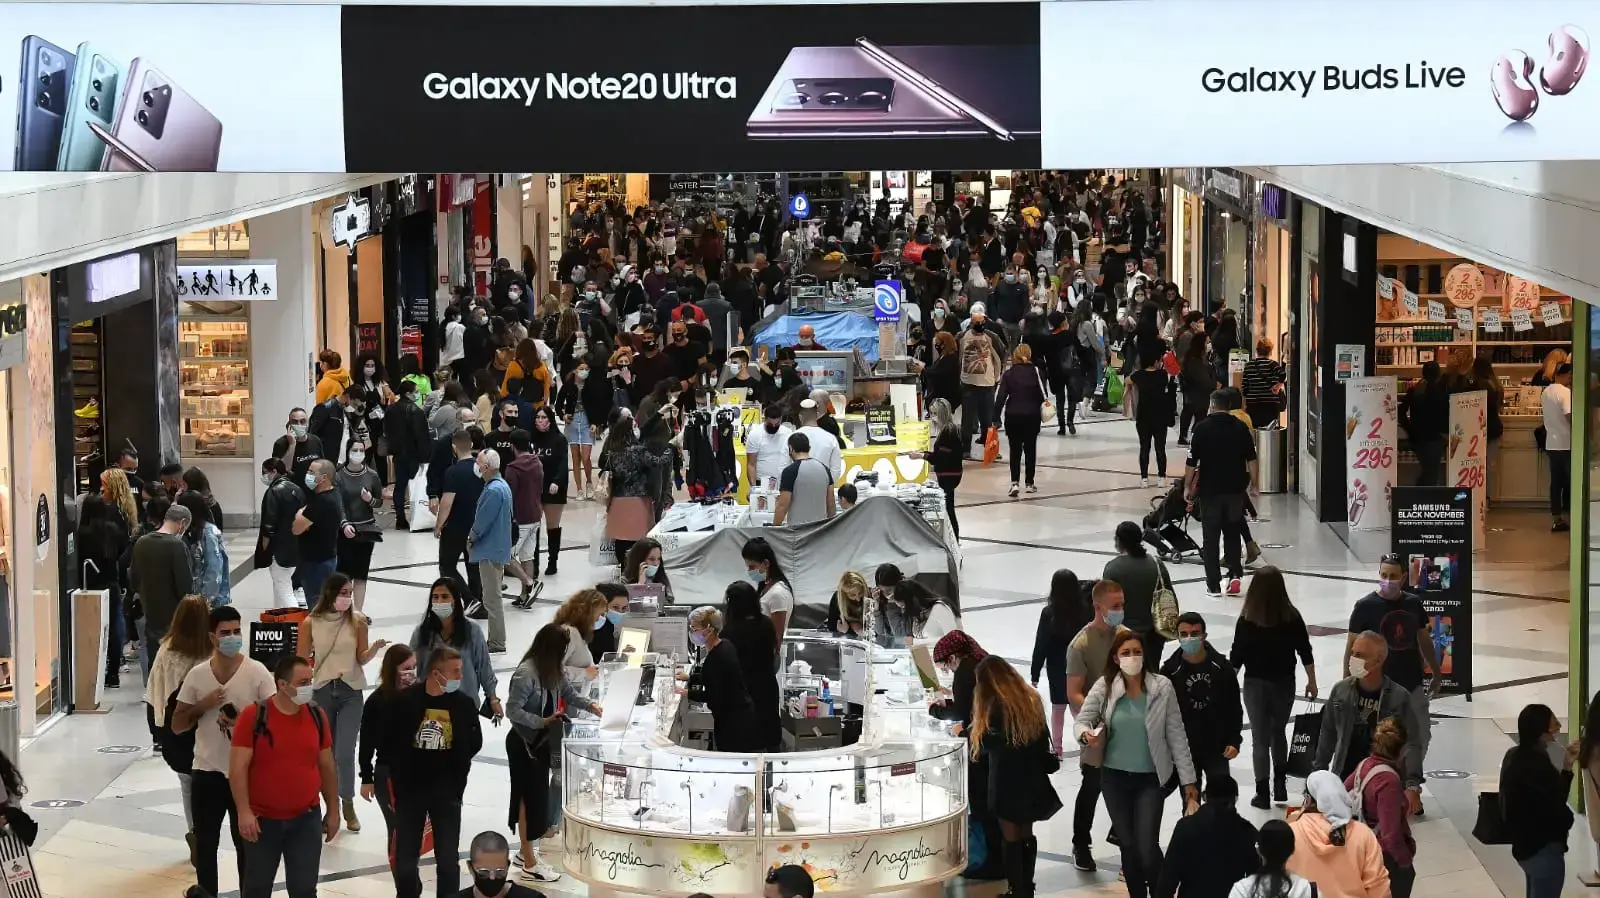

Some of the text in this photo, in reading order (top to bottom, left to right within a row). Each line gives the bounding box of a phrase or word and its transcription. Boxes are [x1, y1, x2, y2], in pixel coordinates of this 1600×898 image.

[1201, 60, 1466, 98] Galaxy Buds Live
[423, 72, 737, 107] Galaxy Note20 Ultra
[1461, 273, 1470, 284] 2
[1519, 281, 1528, 293] 2
[1454, 288, 1476, 301] 295
[1513, 297, 1532, 309] 295
[1367, 417, 1383, 439] 2
[1468, 435, 1479, 457] 2
[1352, 447, 1394, 469] 295
[1456, 465, 1484, 488] 295
[1398, 511, 1465, 519] BLACK NOVEMBER
[1412, 503, 1450, 511] SAMSUNG
[255, 630, 283, 641] NYOU
[862, 836, 944, 881] Magnolia
